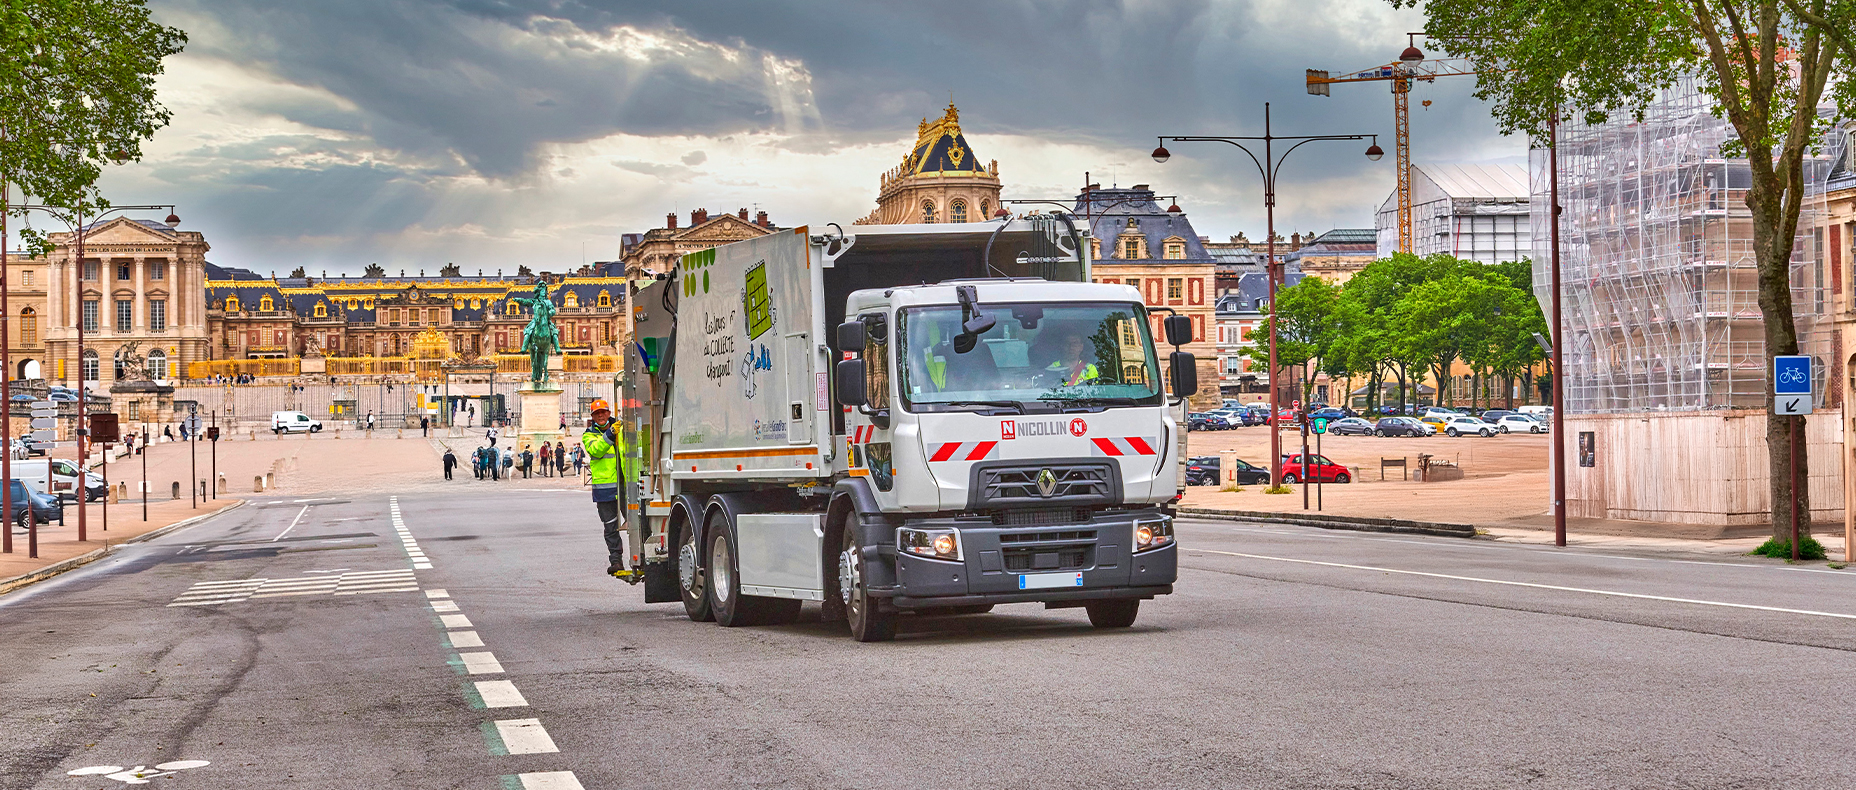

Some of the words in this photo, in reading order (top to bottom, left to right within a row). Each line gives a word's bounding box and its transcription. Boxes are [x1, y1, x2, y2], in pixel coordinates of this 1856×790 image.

[1003, 421, 1013, 434] N
[1018, 421, 1067, 436] NICOLLIN
[1073, 422, 1083, 433] N
